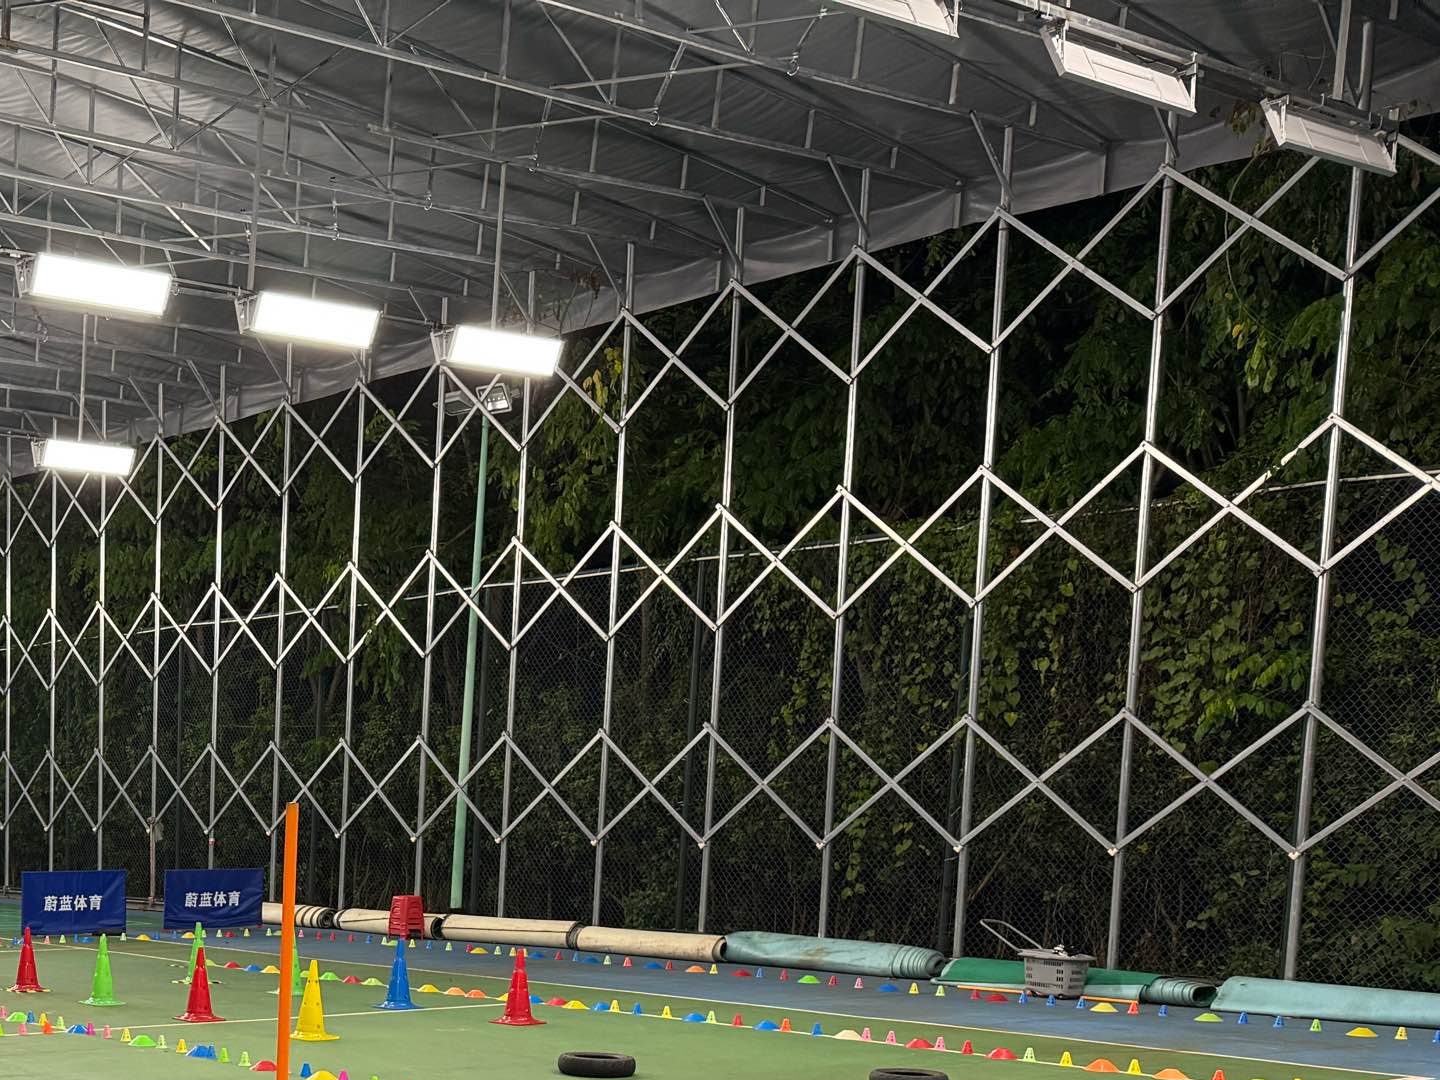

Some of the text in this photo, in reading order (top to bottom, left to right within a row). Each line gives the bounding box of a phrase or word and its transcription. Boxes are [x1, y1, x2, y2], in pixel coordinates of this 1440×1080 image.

[43, 894, 103, 912] 蔚蓝体育
[184, 890, 241, 908] 蔚蓝体育
